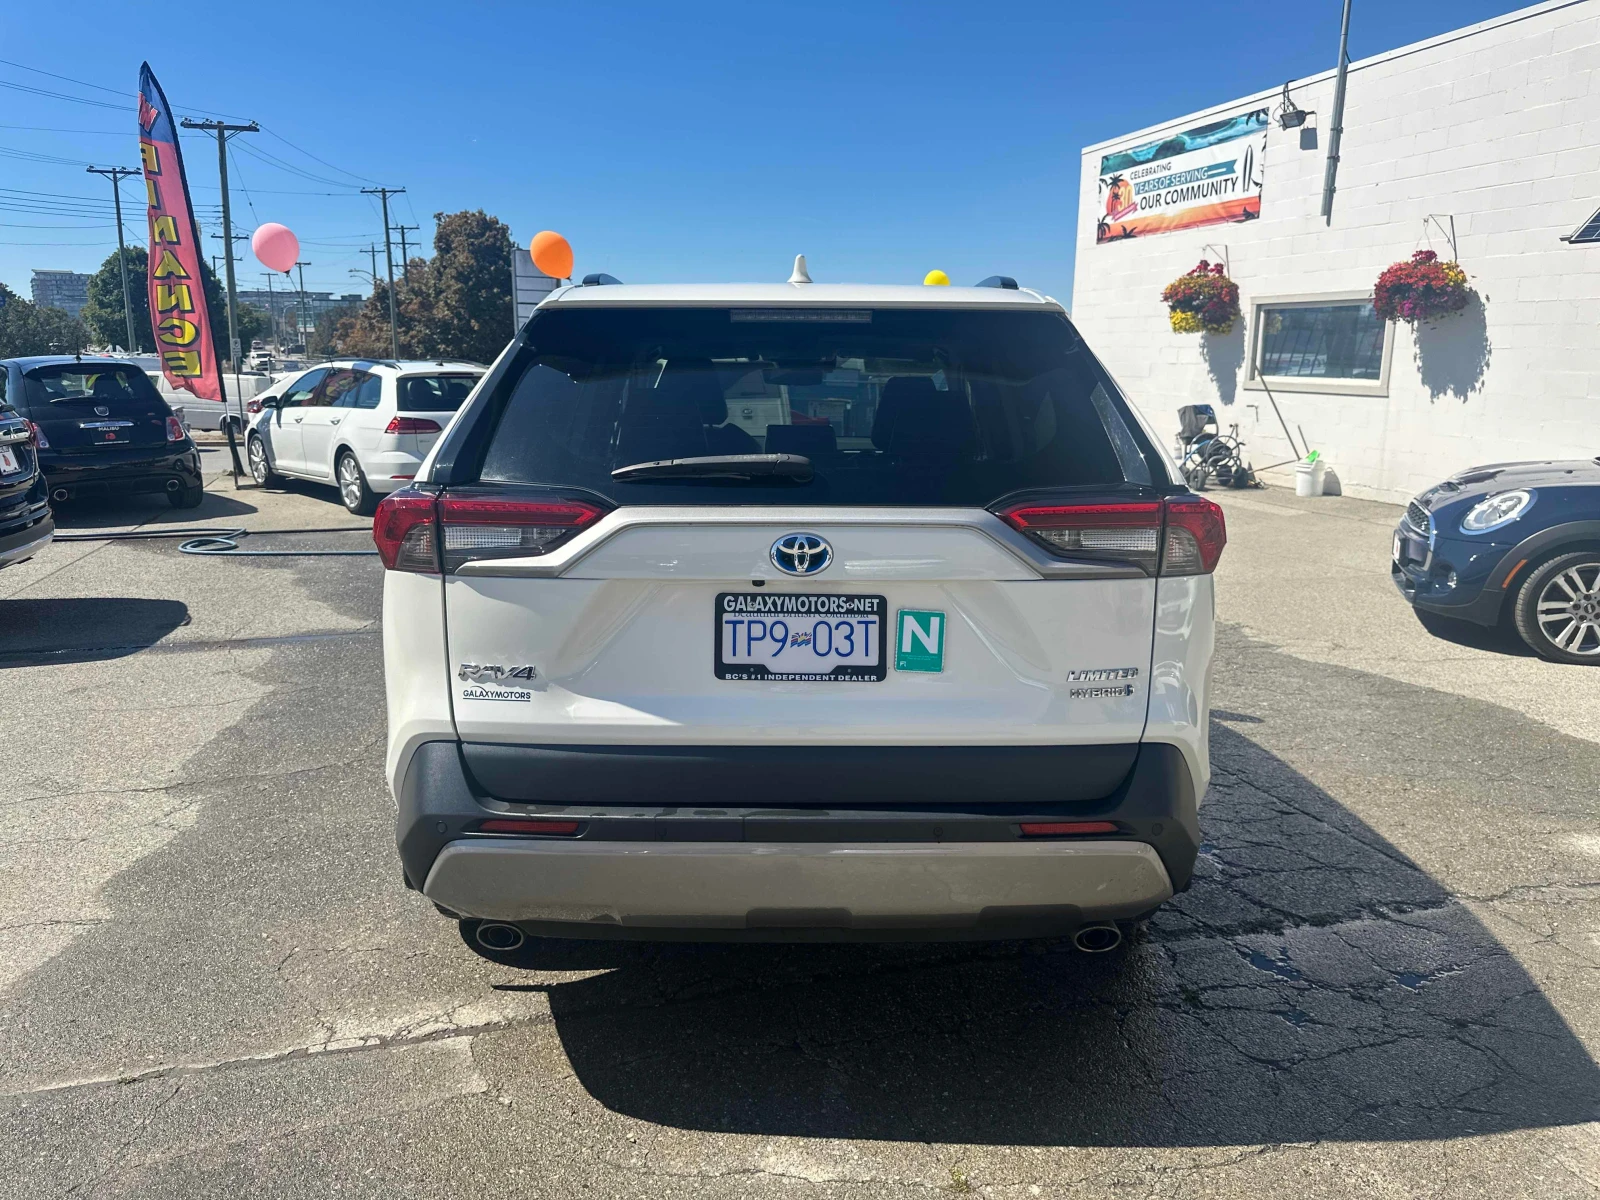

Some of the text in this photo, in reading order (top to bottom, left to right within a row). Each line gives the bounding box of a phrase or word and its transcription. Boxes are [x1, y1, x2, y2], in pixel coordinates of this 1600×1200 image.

[1130, 162, 1172, 180] CELEBRATING
[1134, 167, 1208, 194] YEARS OF SERVING
[1117, 185, 1133, 211] 30
[1140, 176, 1239, 210] OUR COMMUNITY
[724, 620, 789, 657] TP9
[902, 615, 940, 654] N
[458, 663, 537, 681] RAV4
[1066, 667, 1139, 682] LIMITED
[463, 689, 531, 700] GALAXYMOTORS
[1070, 687, 1126, 699] HYBRID
